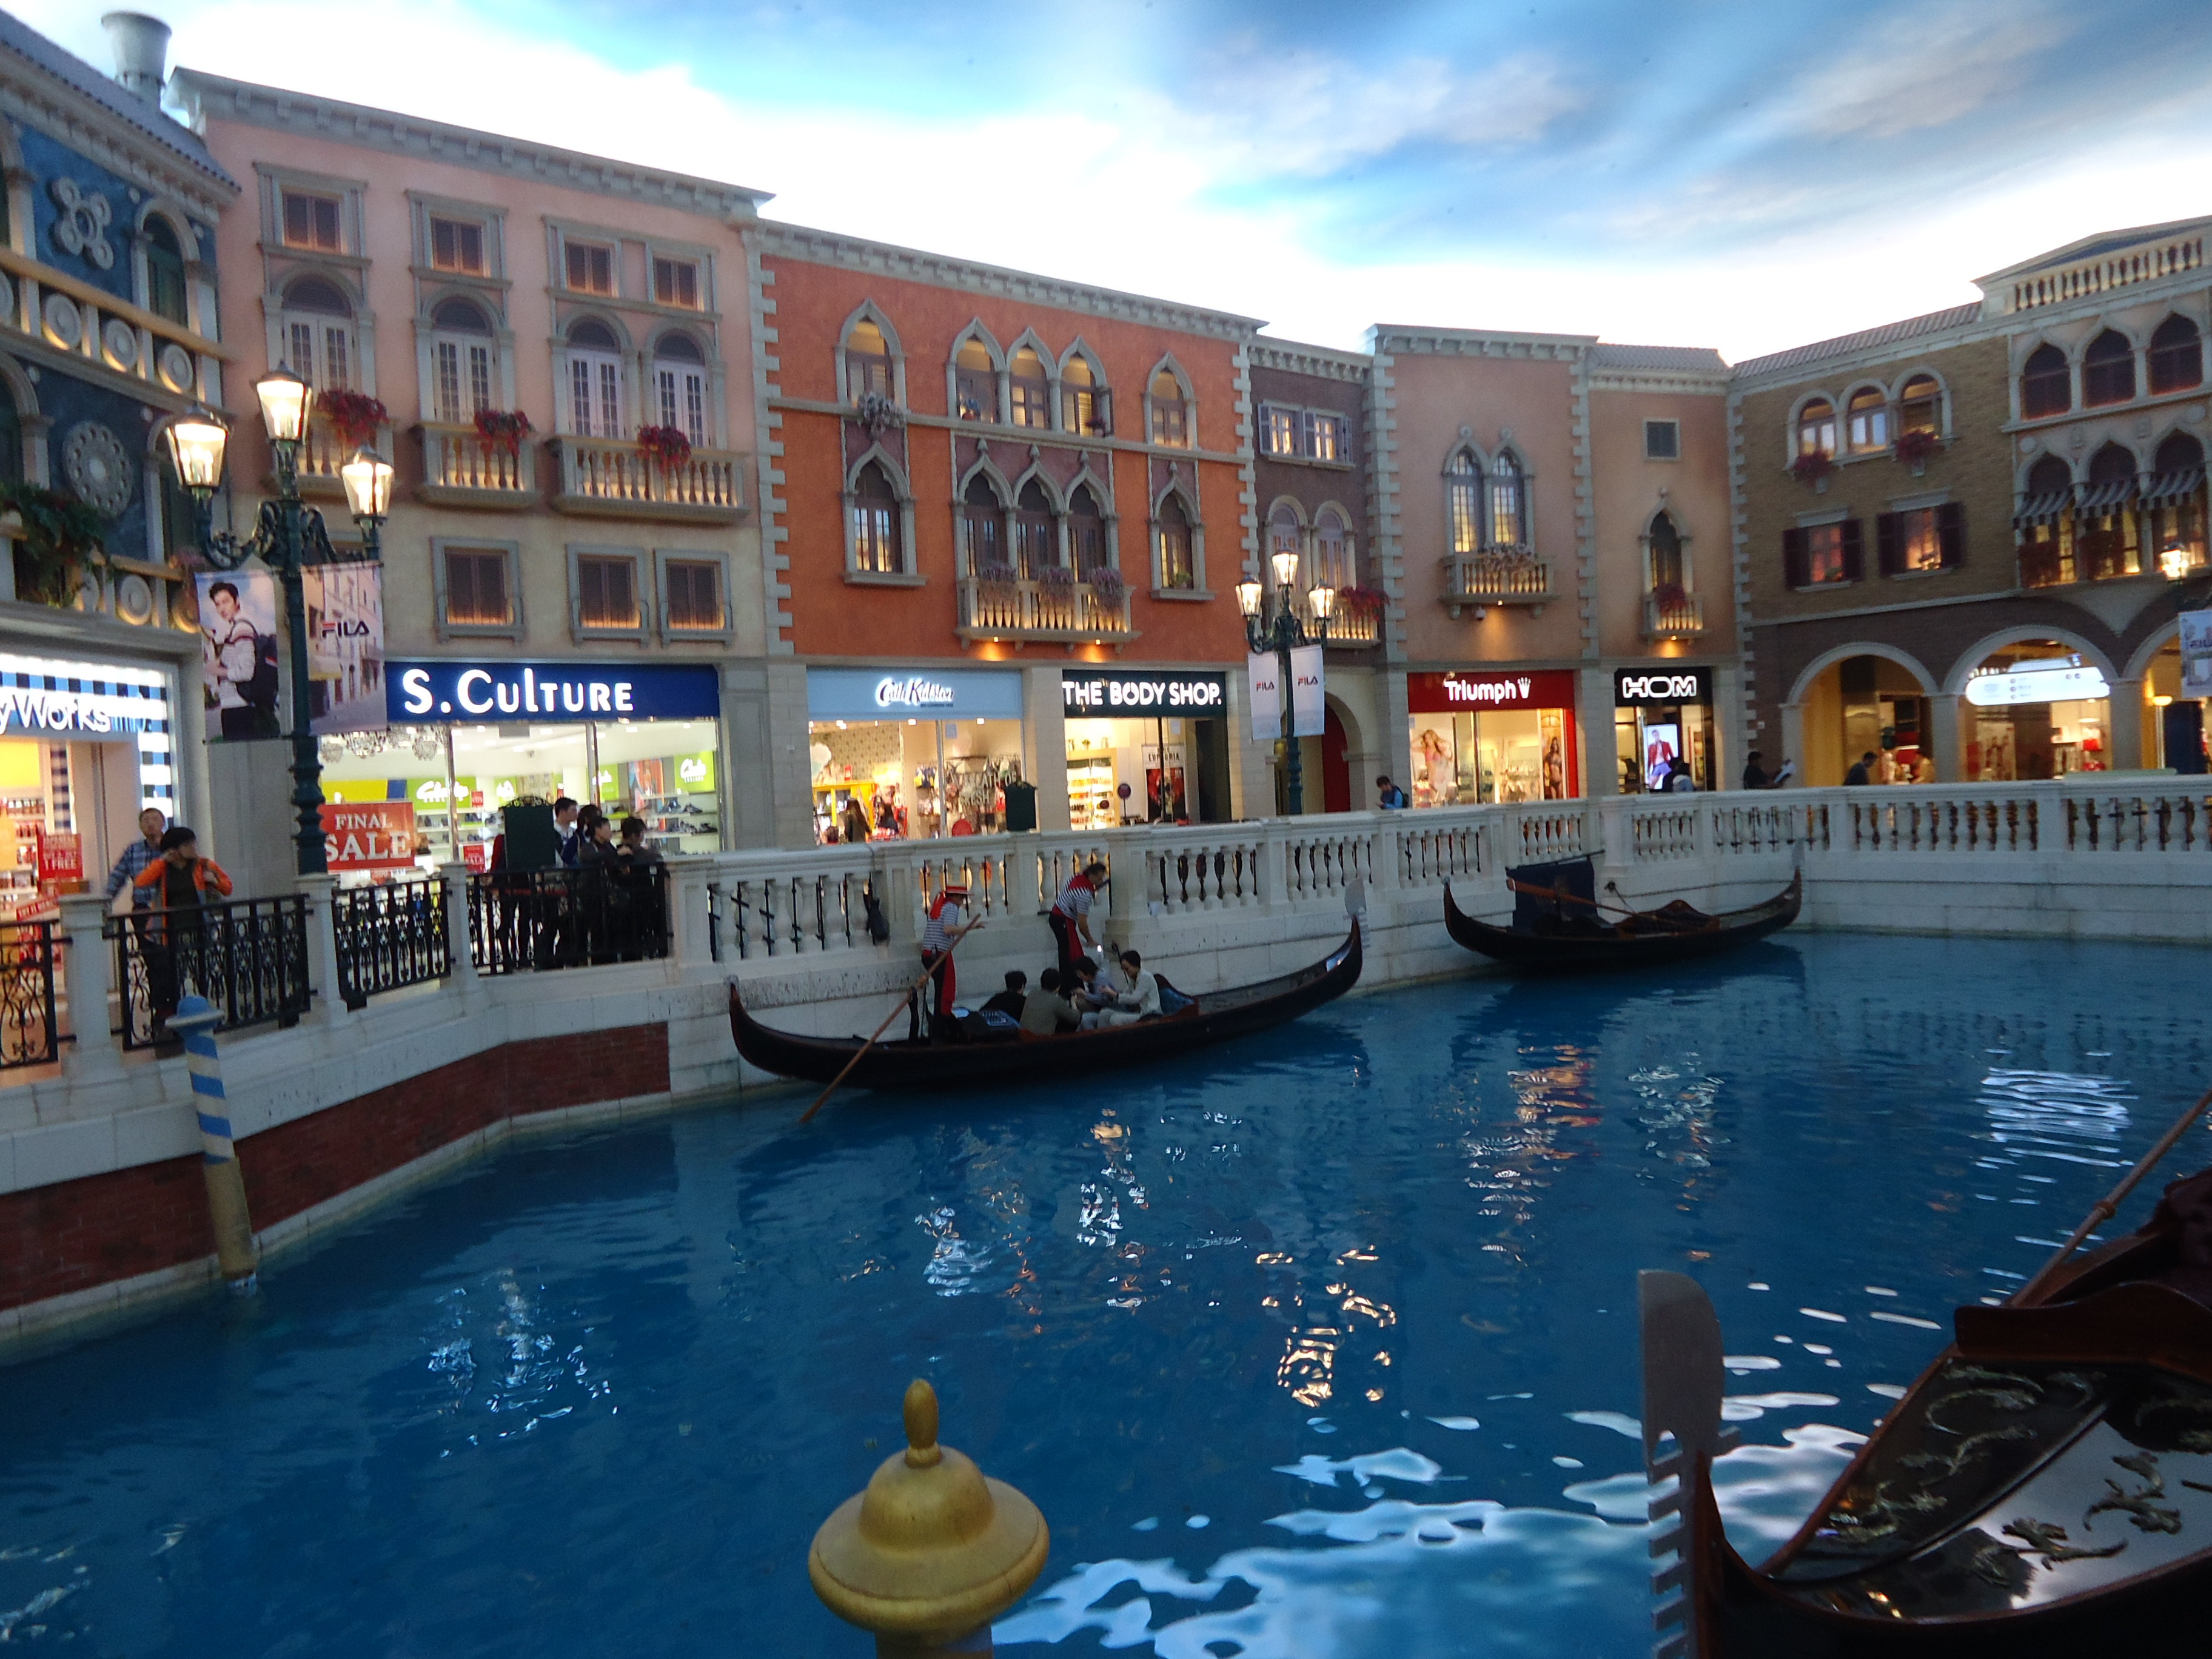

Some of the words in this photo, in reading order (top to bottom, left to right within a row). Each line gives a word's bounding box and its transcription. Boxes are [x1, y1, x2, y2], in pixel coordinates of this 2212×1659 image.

[322, 621, 370, 638] FILA
[2190, 639, 2212, 648] FIL
[1256, 680, 1275, 692] FILA
[1298, 676, 1318, 687] FILA
[1622, 675, 1697, 699] HOM
[1062, 681, 1104, 705] THE
[1110, 682, 1166, 706] BODY
[1444, 679, 1517, 705] Triumph
[1148, 752, 1179, 762] EUPORIA
[335, 812, 393, 831] FINAL
[324, 830, 412, 862] SALE
